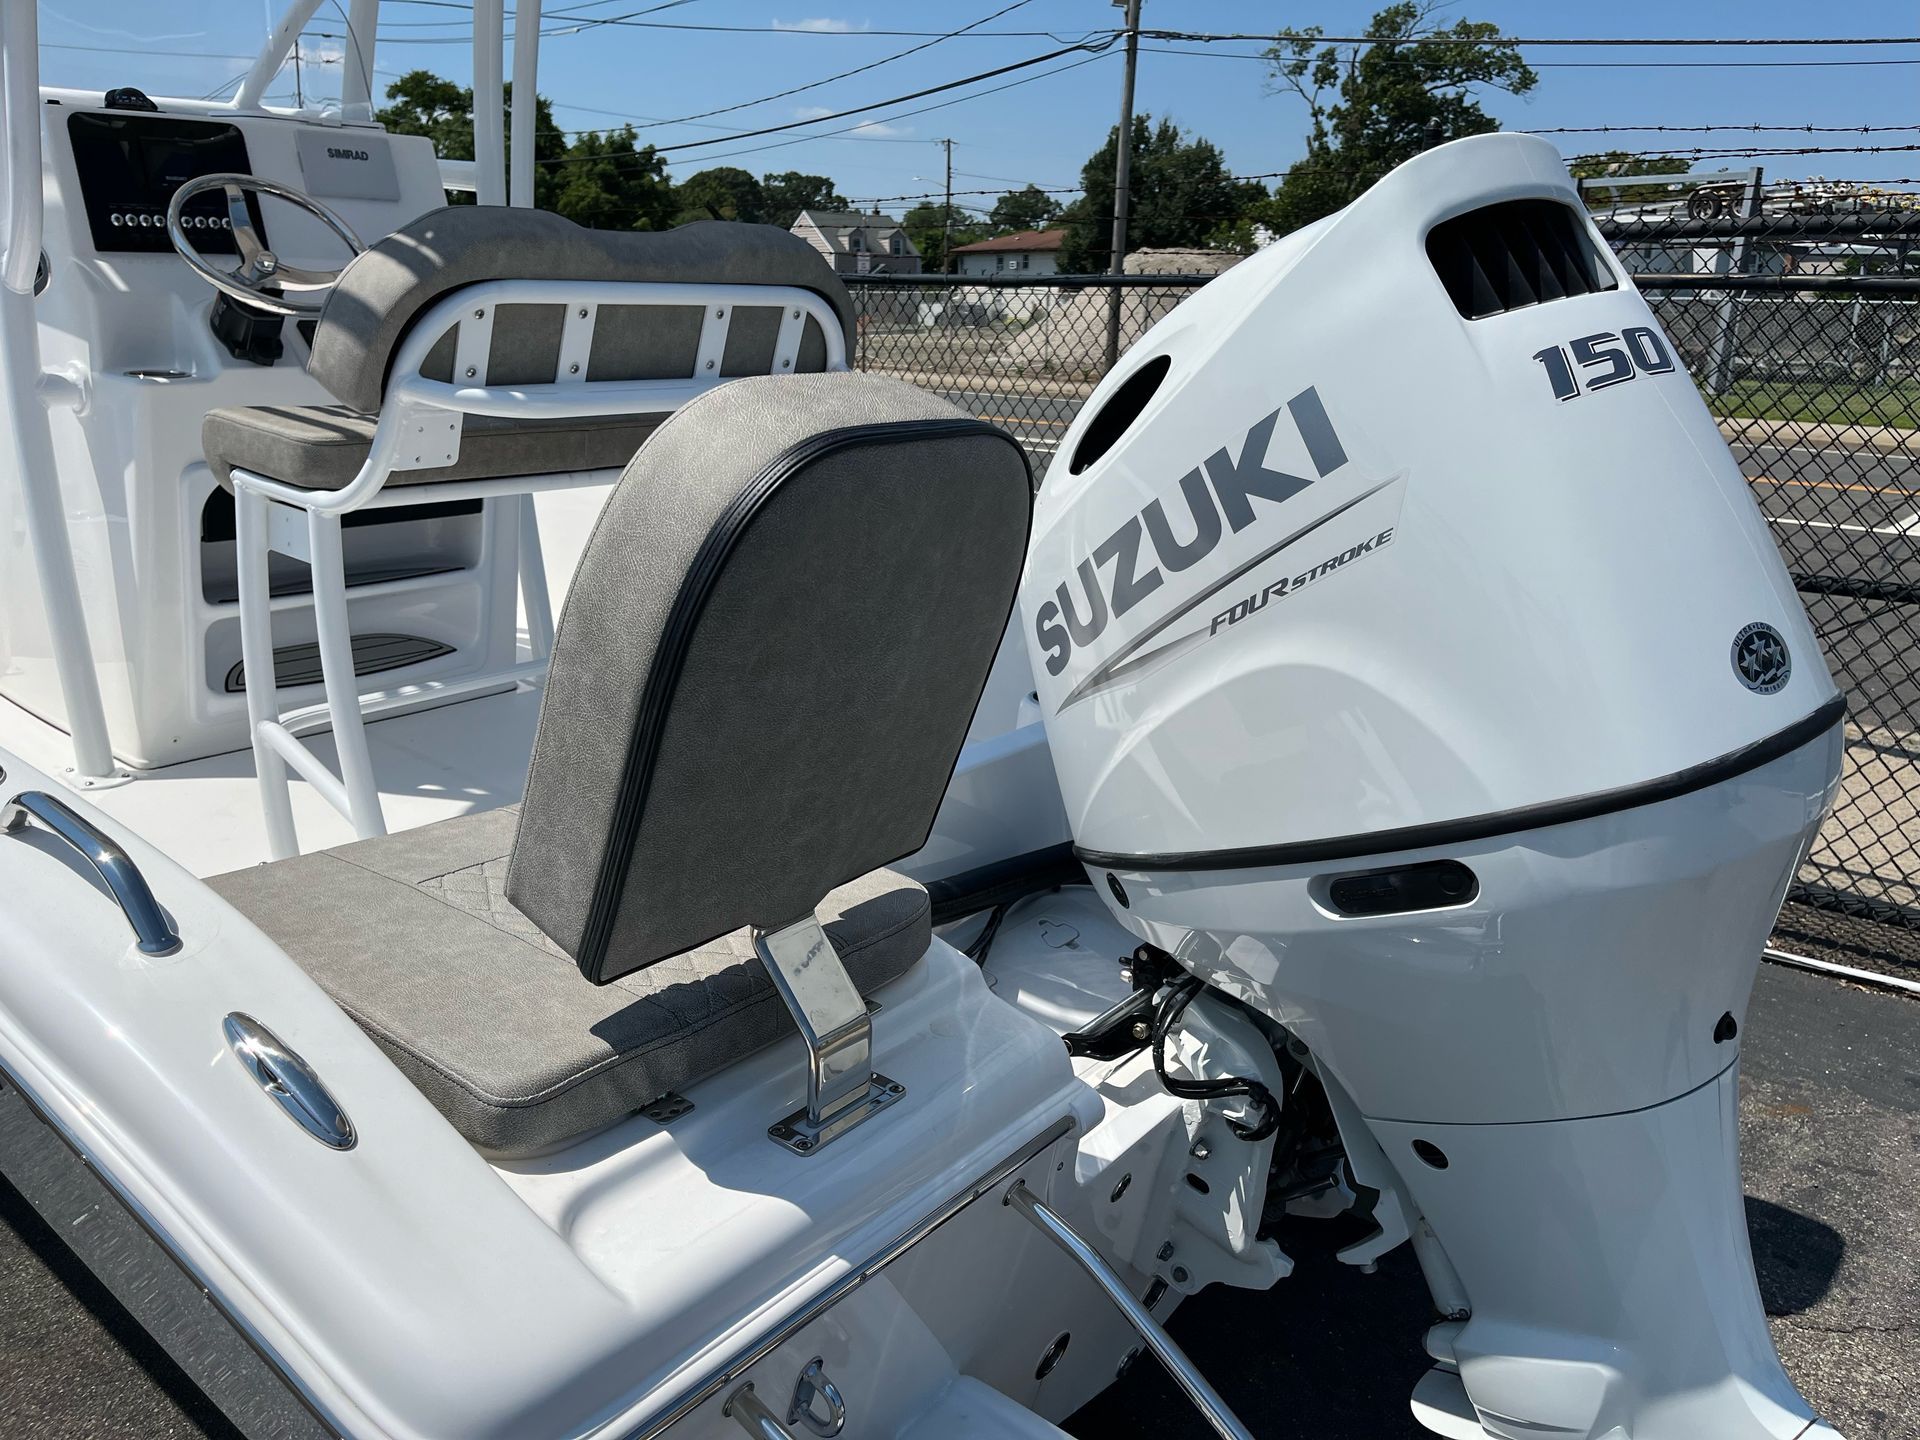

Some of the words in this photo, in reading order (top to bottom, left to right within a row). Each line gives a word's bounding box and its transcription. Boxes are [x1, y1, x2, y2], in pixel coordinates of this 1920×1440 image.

[327, 148, 369, 161] SIMRAD
[1532, 326, 1676, 402] 150
[1036, 385, 1349, 677] SUZUKI
